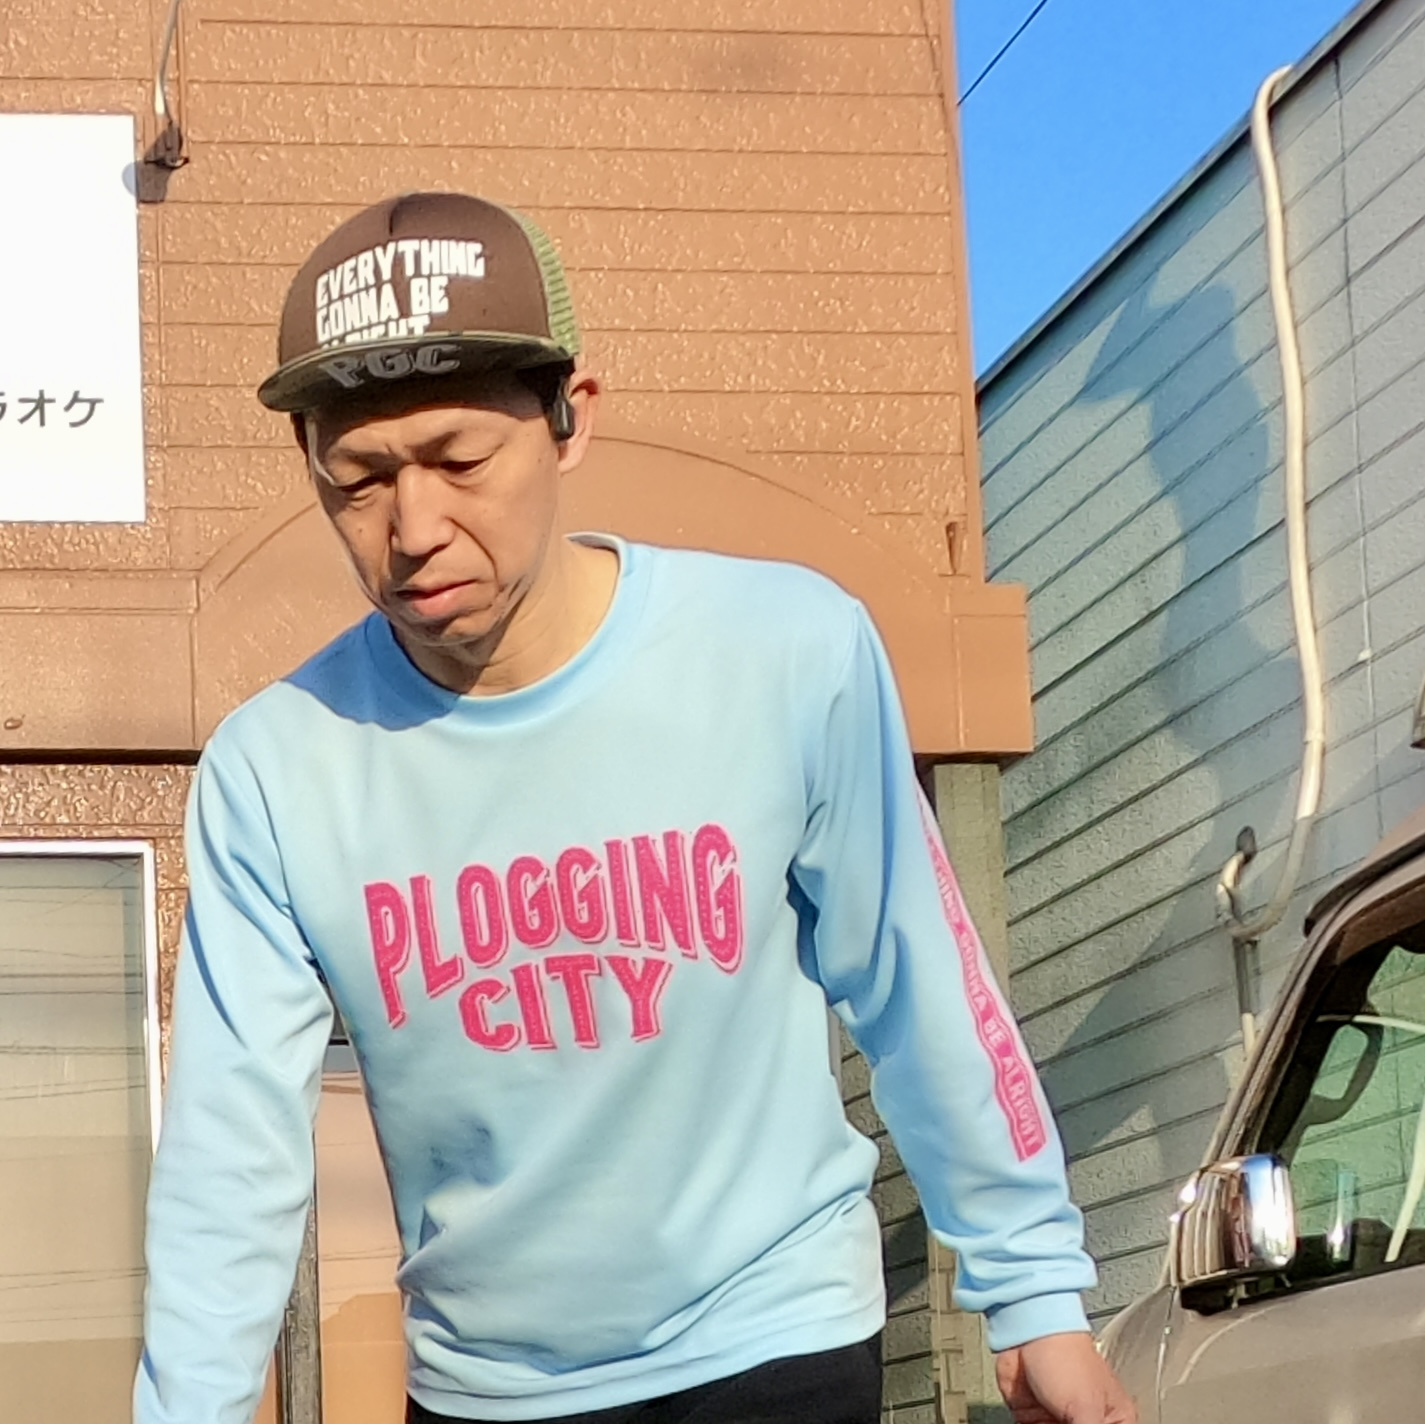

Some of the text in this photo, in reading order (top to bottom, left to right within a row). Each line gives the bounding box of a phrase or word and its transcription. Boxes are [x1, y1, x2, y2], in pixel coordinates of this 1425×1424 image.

[315, 238, 486, 309] EVERYTHING
[315, 282, 401, 345] GONNA
[409, 275, 450, 315] BE
[318, 344, 462, 388] PGC
[363, 822, 743, 1029] PLOGGING
[458, 953, 674, 1051] CITY
[983, 1016, 1007, 1048] BE
[1002, 1056, 1041, 1147] ALRIGHT
